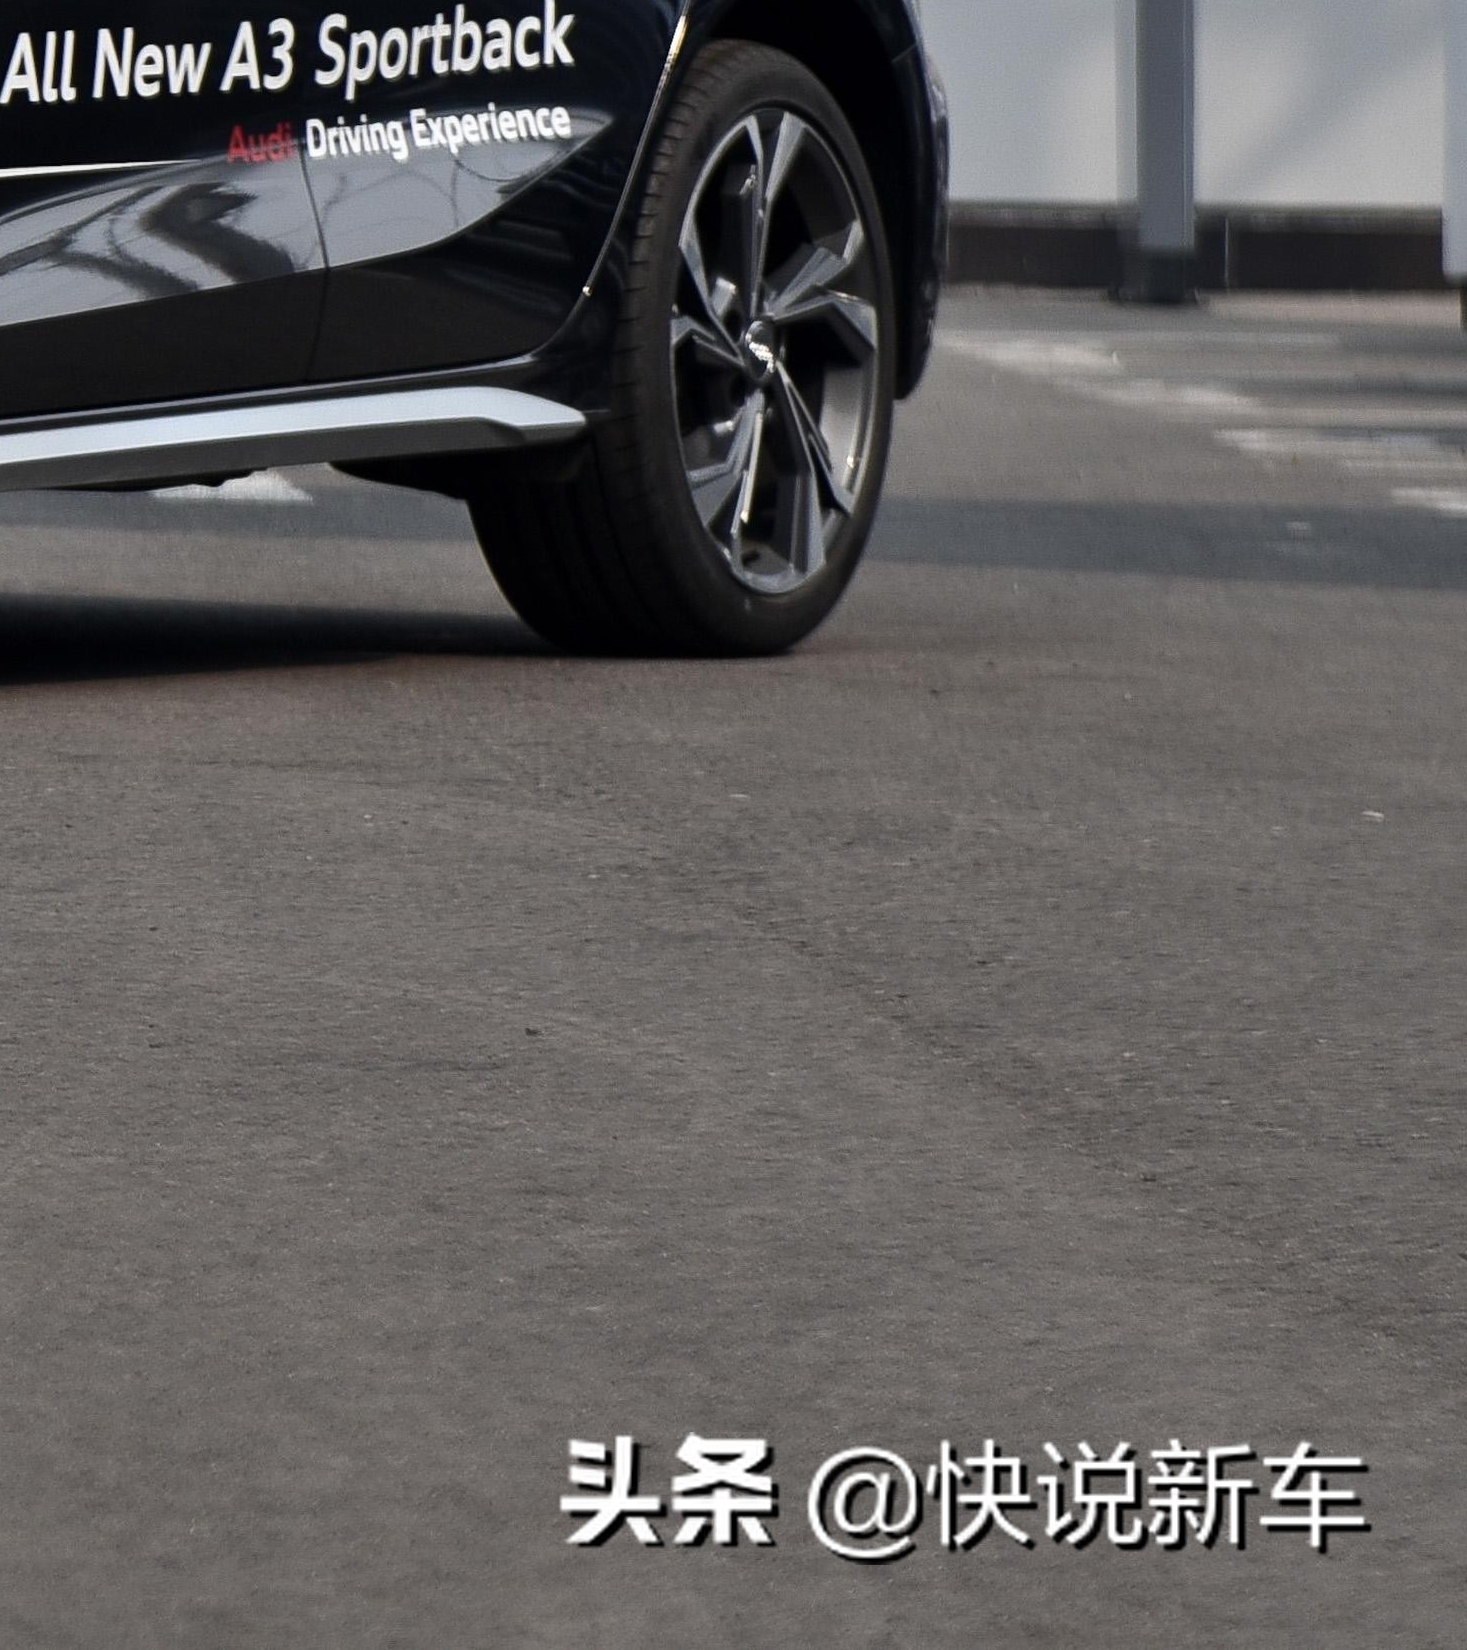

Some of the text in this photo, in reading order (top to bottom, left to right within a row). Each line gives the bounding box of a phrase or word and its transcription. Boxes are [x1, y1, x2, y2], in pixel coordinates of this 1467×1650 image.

[0, 30, 77, 105] All
[93, 27, 211, 100] New
[220, 17, 293, 93] A3
[225, 103, 571, 164] Audi Driving Experience
